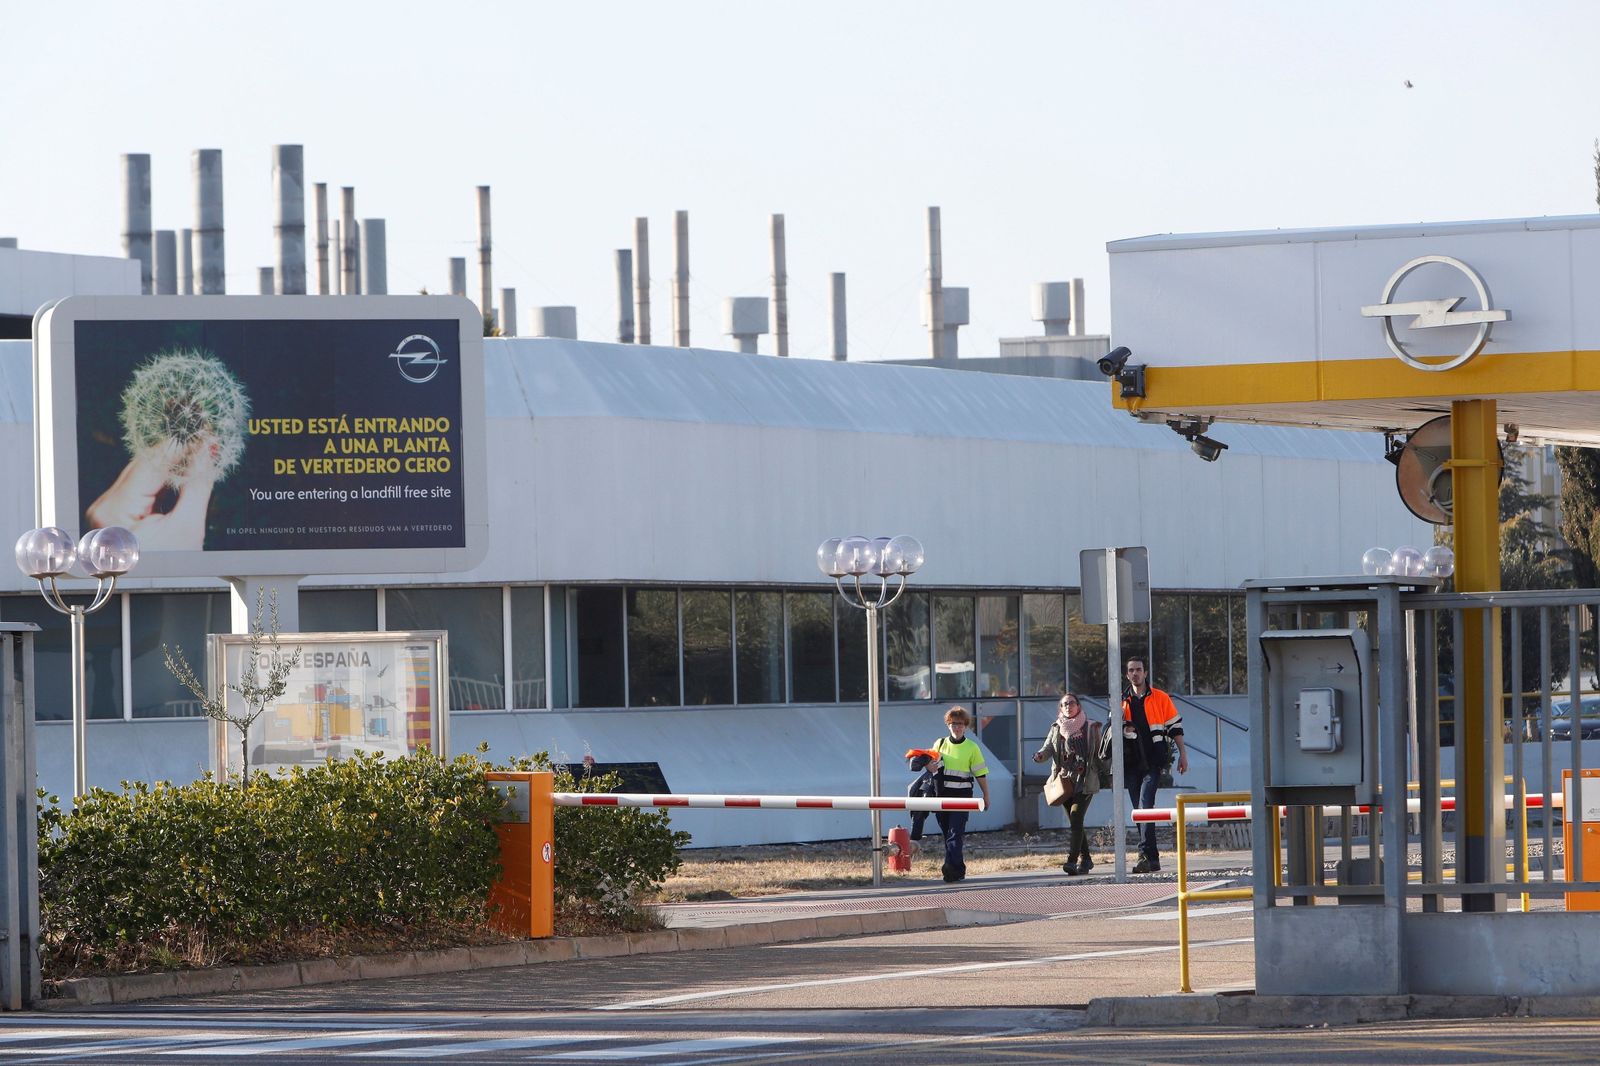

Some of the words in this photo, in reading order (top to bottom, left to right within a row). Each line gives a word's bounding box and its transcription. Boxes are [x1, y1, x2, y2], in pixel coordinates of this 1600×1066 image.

[248, 418, 304, 434] USTED
[308, 414, 350, 433] ESTÁ
[354, 417, 450, 433] ENTRANDO
[323, 438, 337, 454] A
[341, 438, 379, 454] UNA
[383, 437, 450, 453] PLANTA
[274, 458, 296, 474] DE
[300, 457, 401, 474] VERTEDERO
[404, 456, 451, 473] CERO
[249, 488, 272, 500] You
[274, 490, 295, 500] are
[297, 487, 348, 502] entering
[350, 489, 358, 499] a
[361, 486, 401, 499] landfill
[404, 485, 428, 498] free
[430, 486, 451, 498] site
[303, 648, 371, 669] ESPAÑA
